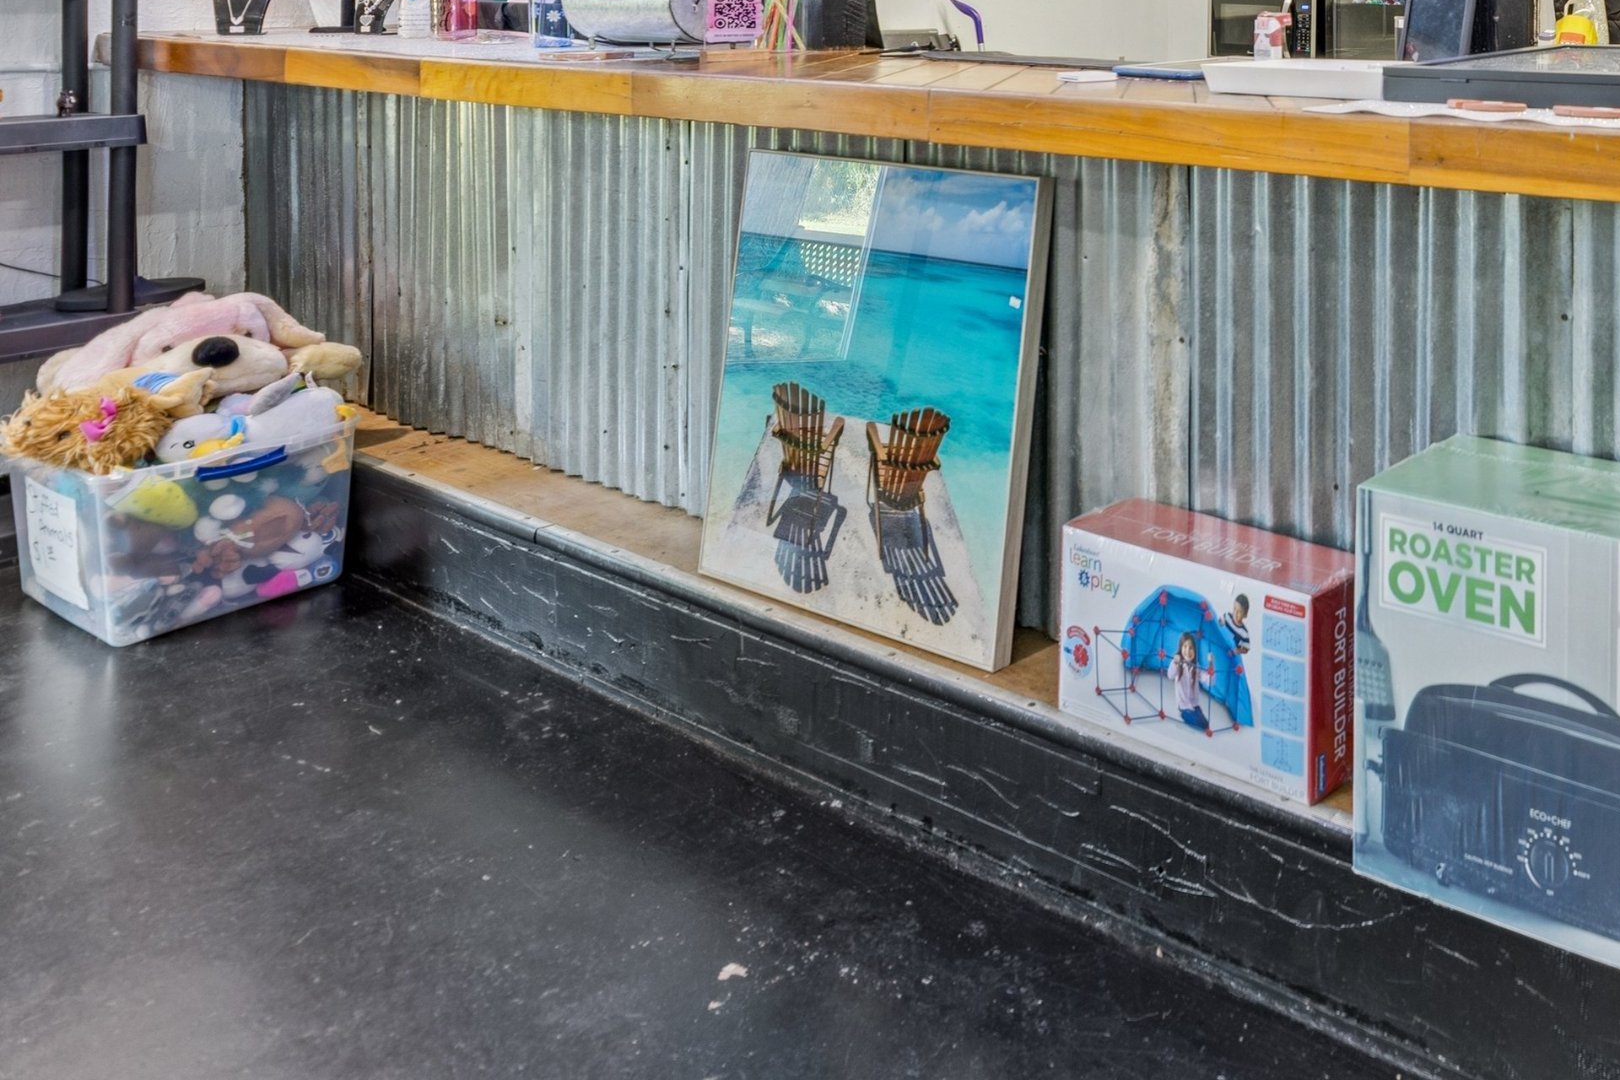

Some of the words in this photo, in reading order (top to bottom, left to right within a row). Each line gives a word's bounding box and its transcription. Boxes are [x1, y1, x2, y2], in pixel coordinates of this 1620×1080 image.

[1141, 527, 1194, 548] FORT
[1193, 541, 1282, 572] BUILDER
[1389, 527, 1536, 585] ROASTER
[1433, 522, 1444, 532] 14
[1446, 525, 1484, 541] QUART
[1069, 547, 1102, 572] learn
[1091, 573, 1120, 598] play
[1388, 560, 1536, 636] OVEN
[1333, 606, 1346, 664] FORT
[1333, 669, 1346, 763] BUILDER
